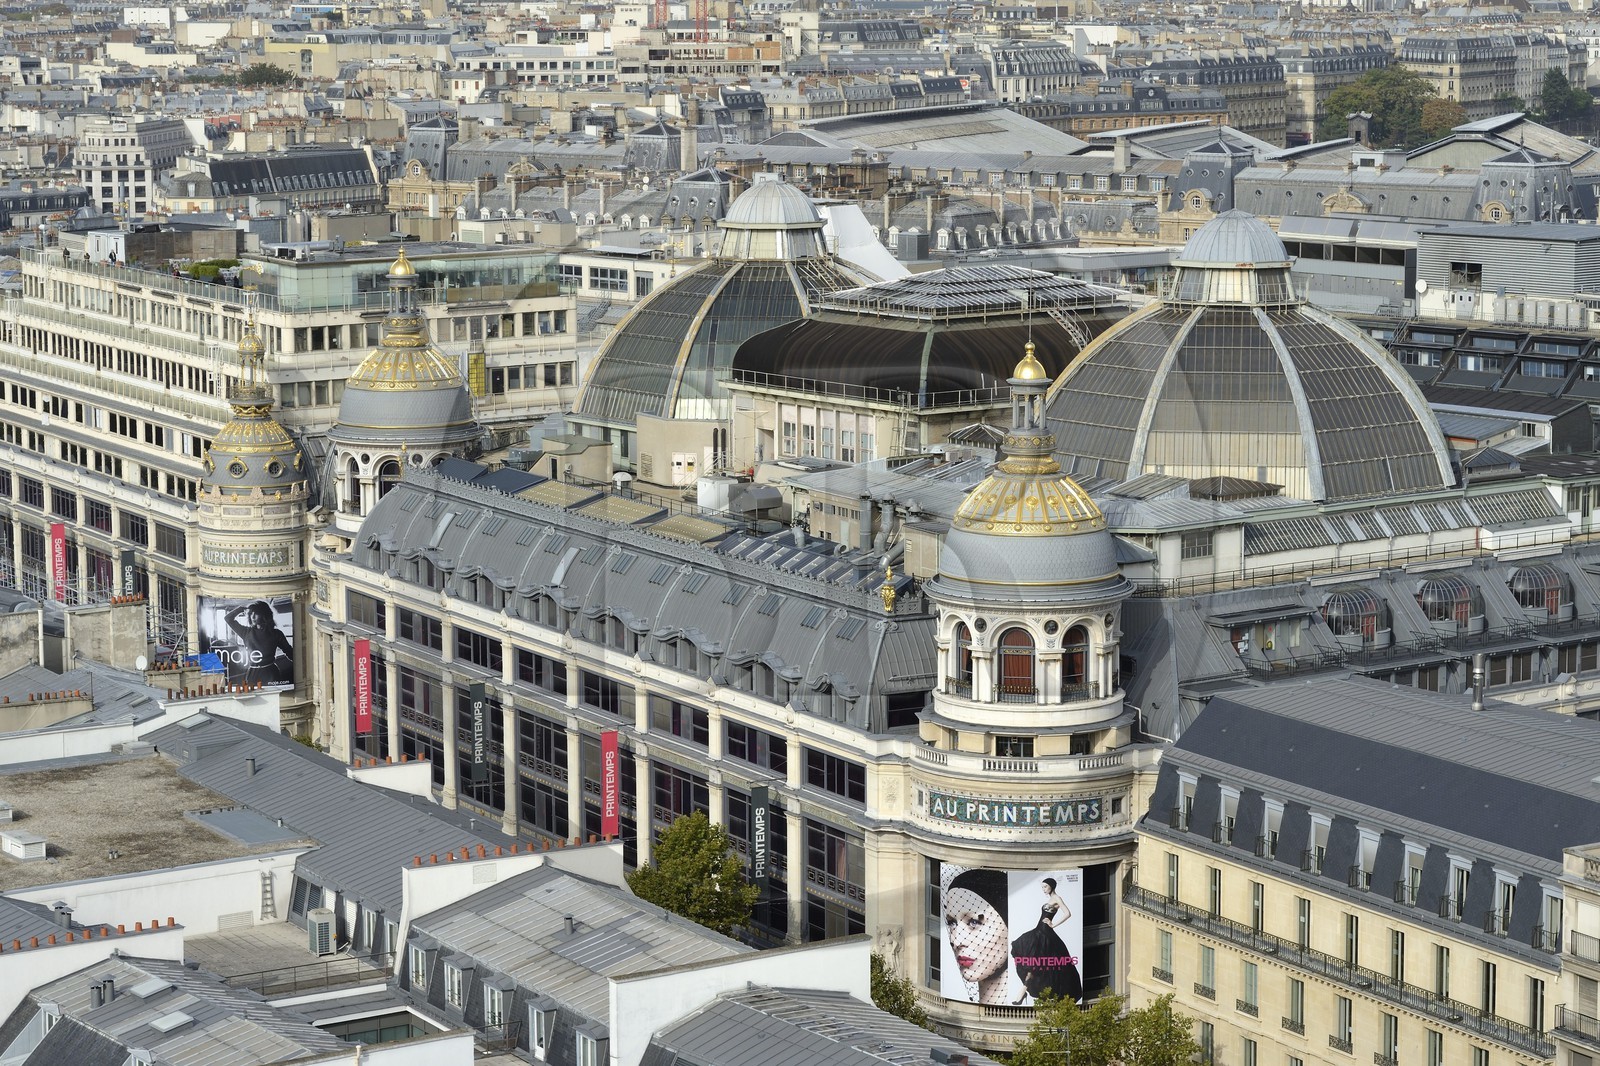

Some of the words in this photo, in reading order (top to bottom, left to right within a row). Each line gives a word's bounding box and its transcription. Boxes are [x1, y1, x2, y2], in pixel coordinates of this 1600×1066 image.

[55, 538, 64, 587] PRINTEMPS
[214, 551, 283, 565] PRINTEMPS
[125, 565, 134, 599] TEMPS
[214, 646, 264, 667] maje
[267, 680, 290, 688] maje.com
[359, 656, 368, 716] PRINTEMPS
[474, 701, 483, 764] PRINTEMPS
[606, 750, 616, 818] PRINTEMPS
[933, 798, 959, 817] AU
[966, 802, 1100, 823] PRINTEMPS
[755, 807, 765, 878] PRINTEMPS
[1014, 956, 1079, 967] PRINTEMPS
